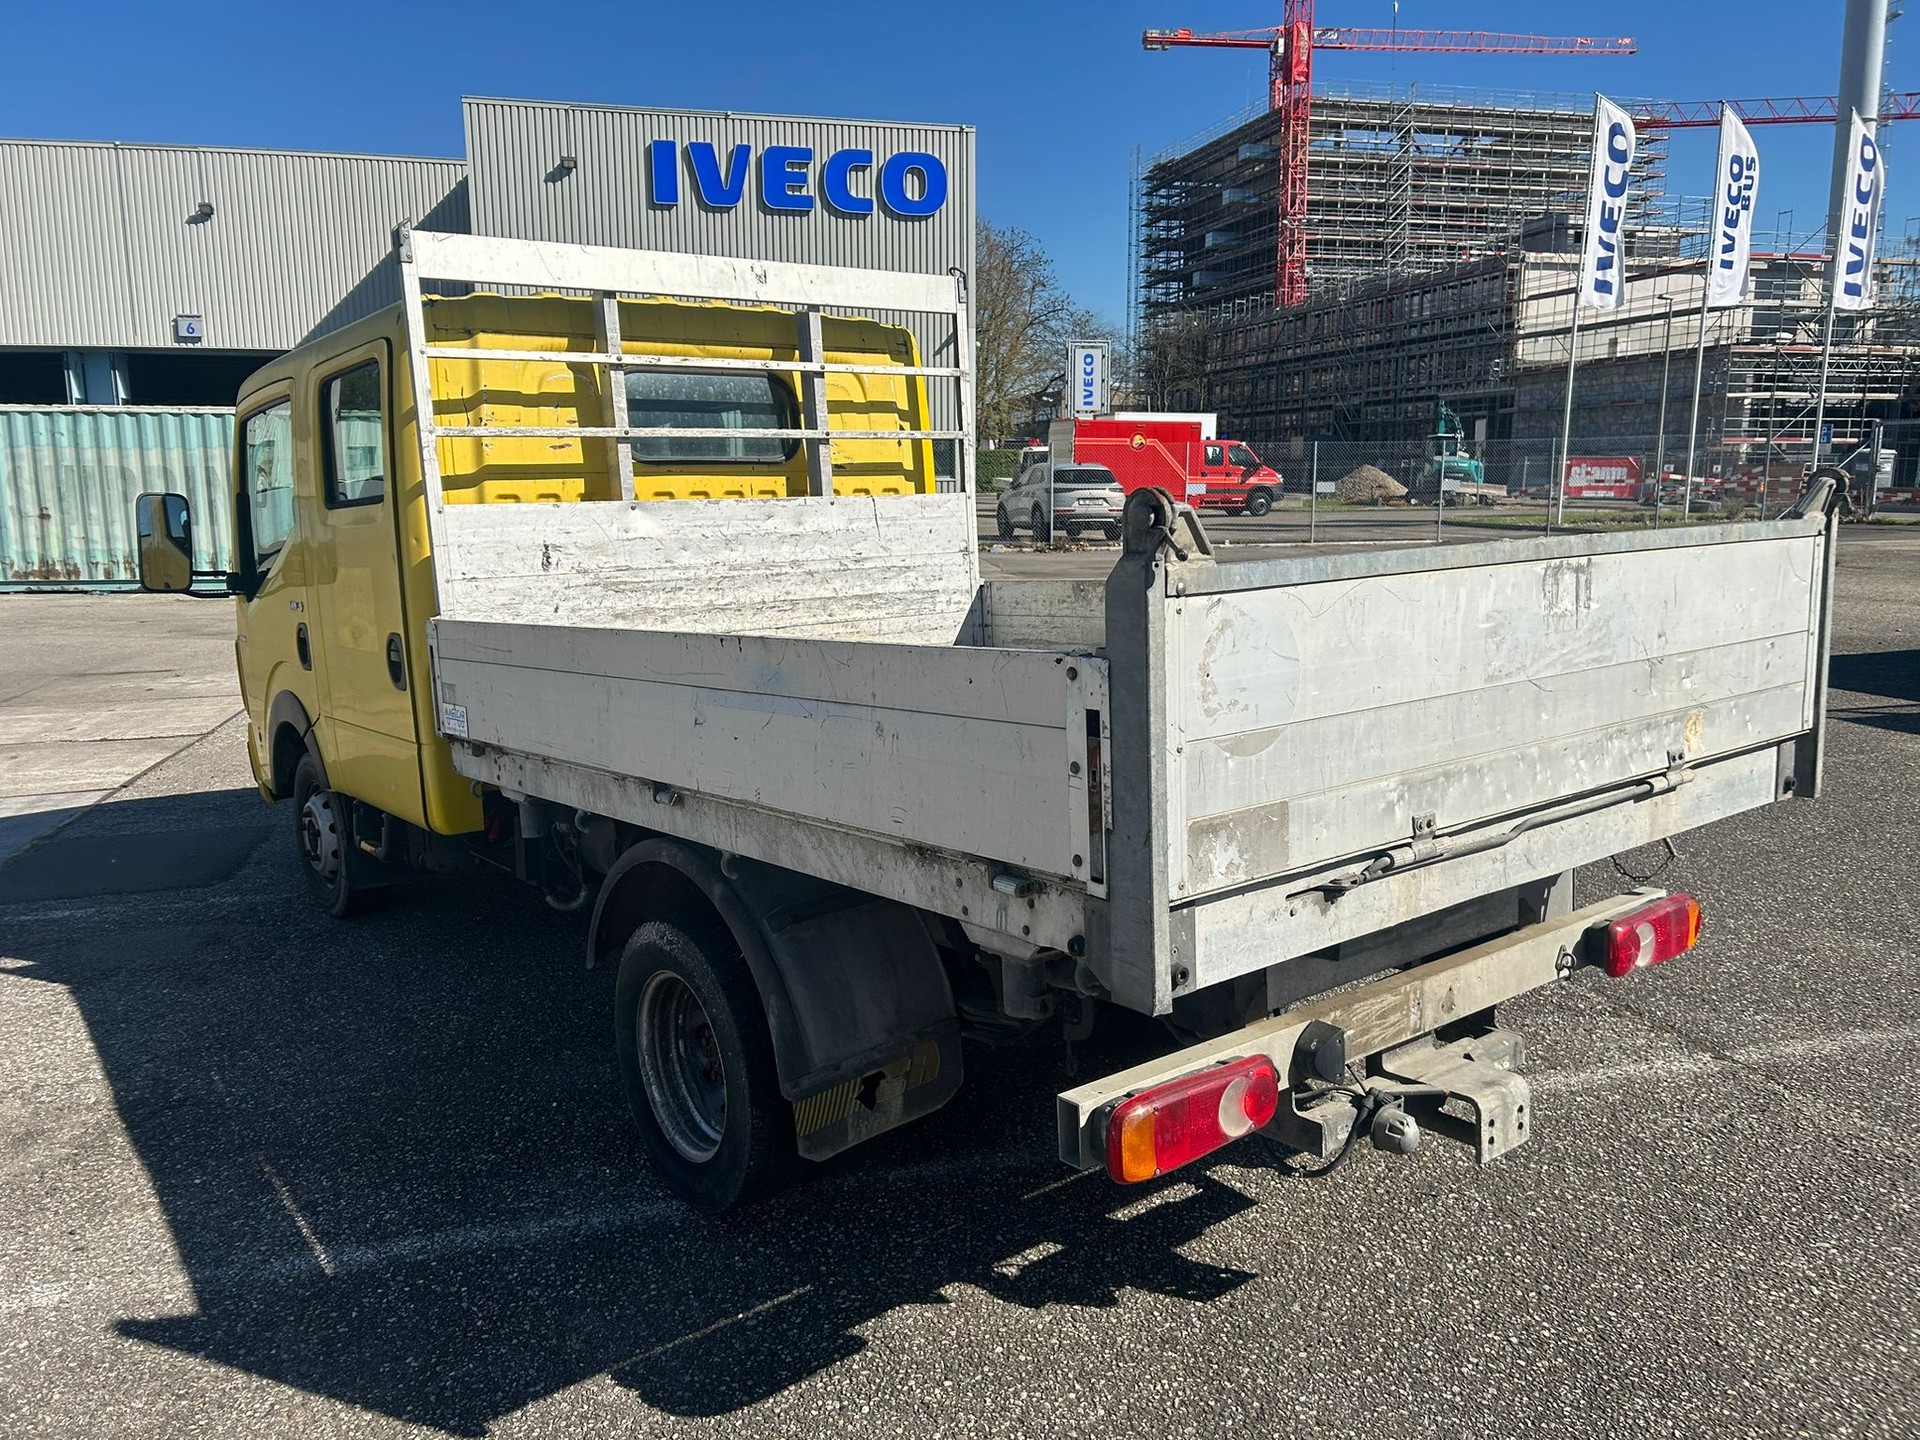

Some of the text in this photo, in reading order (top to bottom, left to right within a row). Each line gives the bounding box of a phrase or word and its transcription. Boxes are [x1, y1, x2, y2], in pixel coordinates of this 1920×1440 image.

[651, 139, 948, 216] IVECO
[1594, 122, 1629, 295] IVECO
[1720, 154, 1744, 270] IVECO
[1740, 156, 1756, 211] BUS
[1844, 133, 1877, 297] IVECO
[186, 322, 195, 335] 6
[1083, 353, 1094, 406] IVECO
